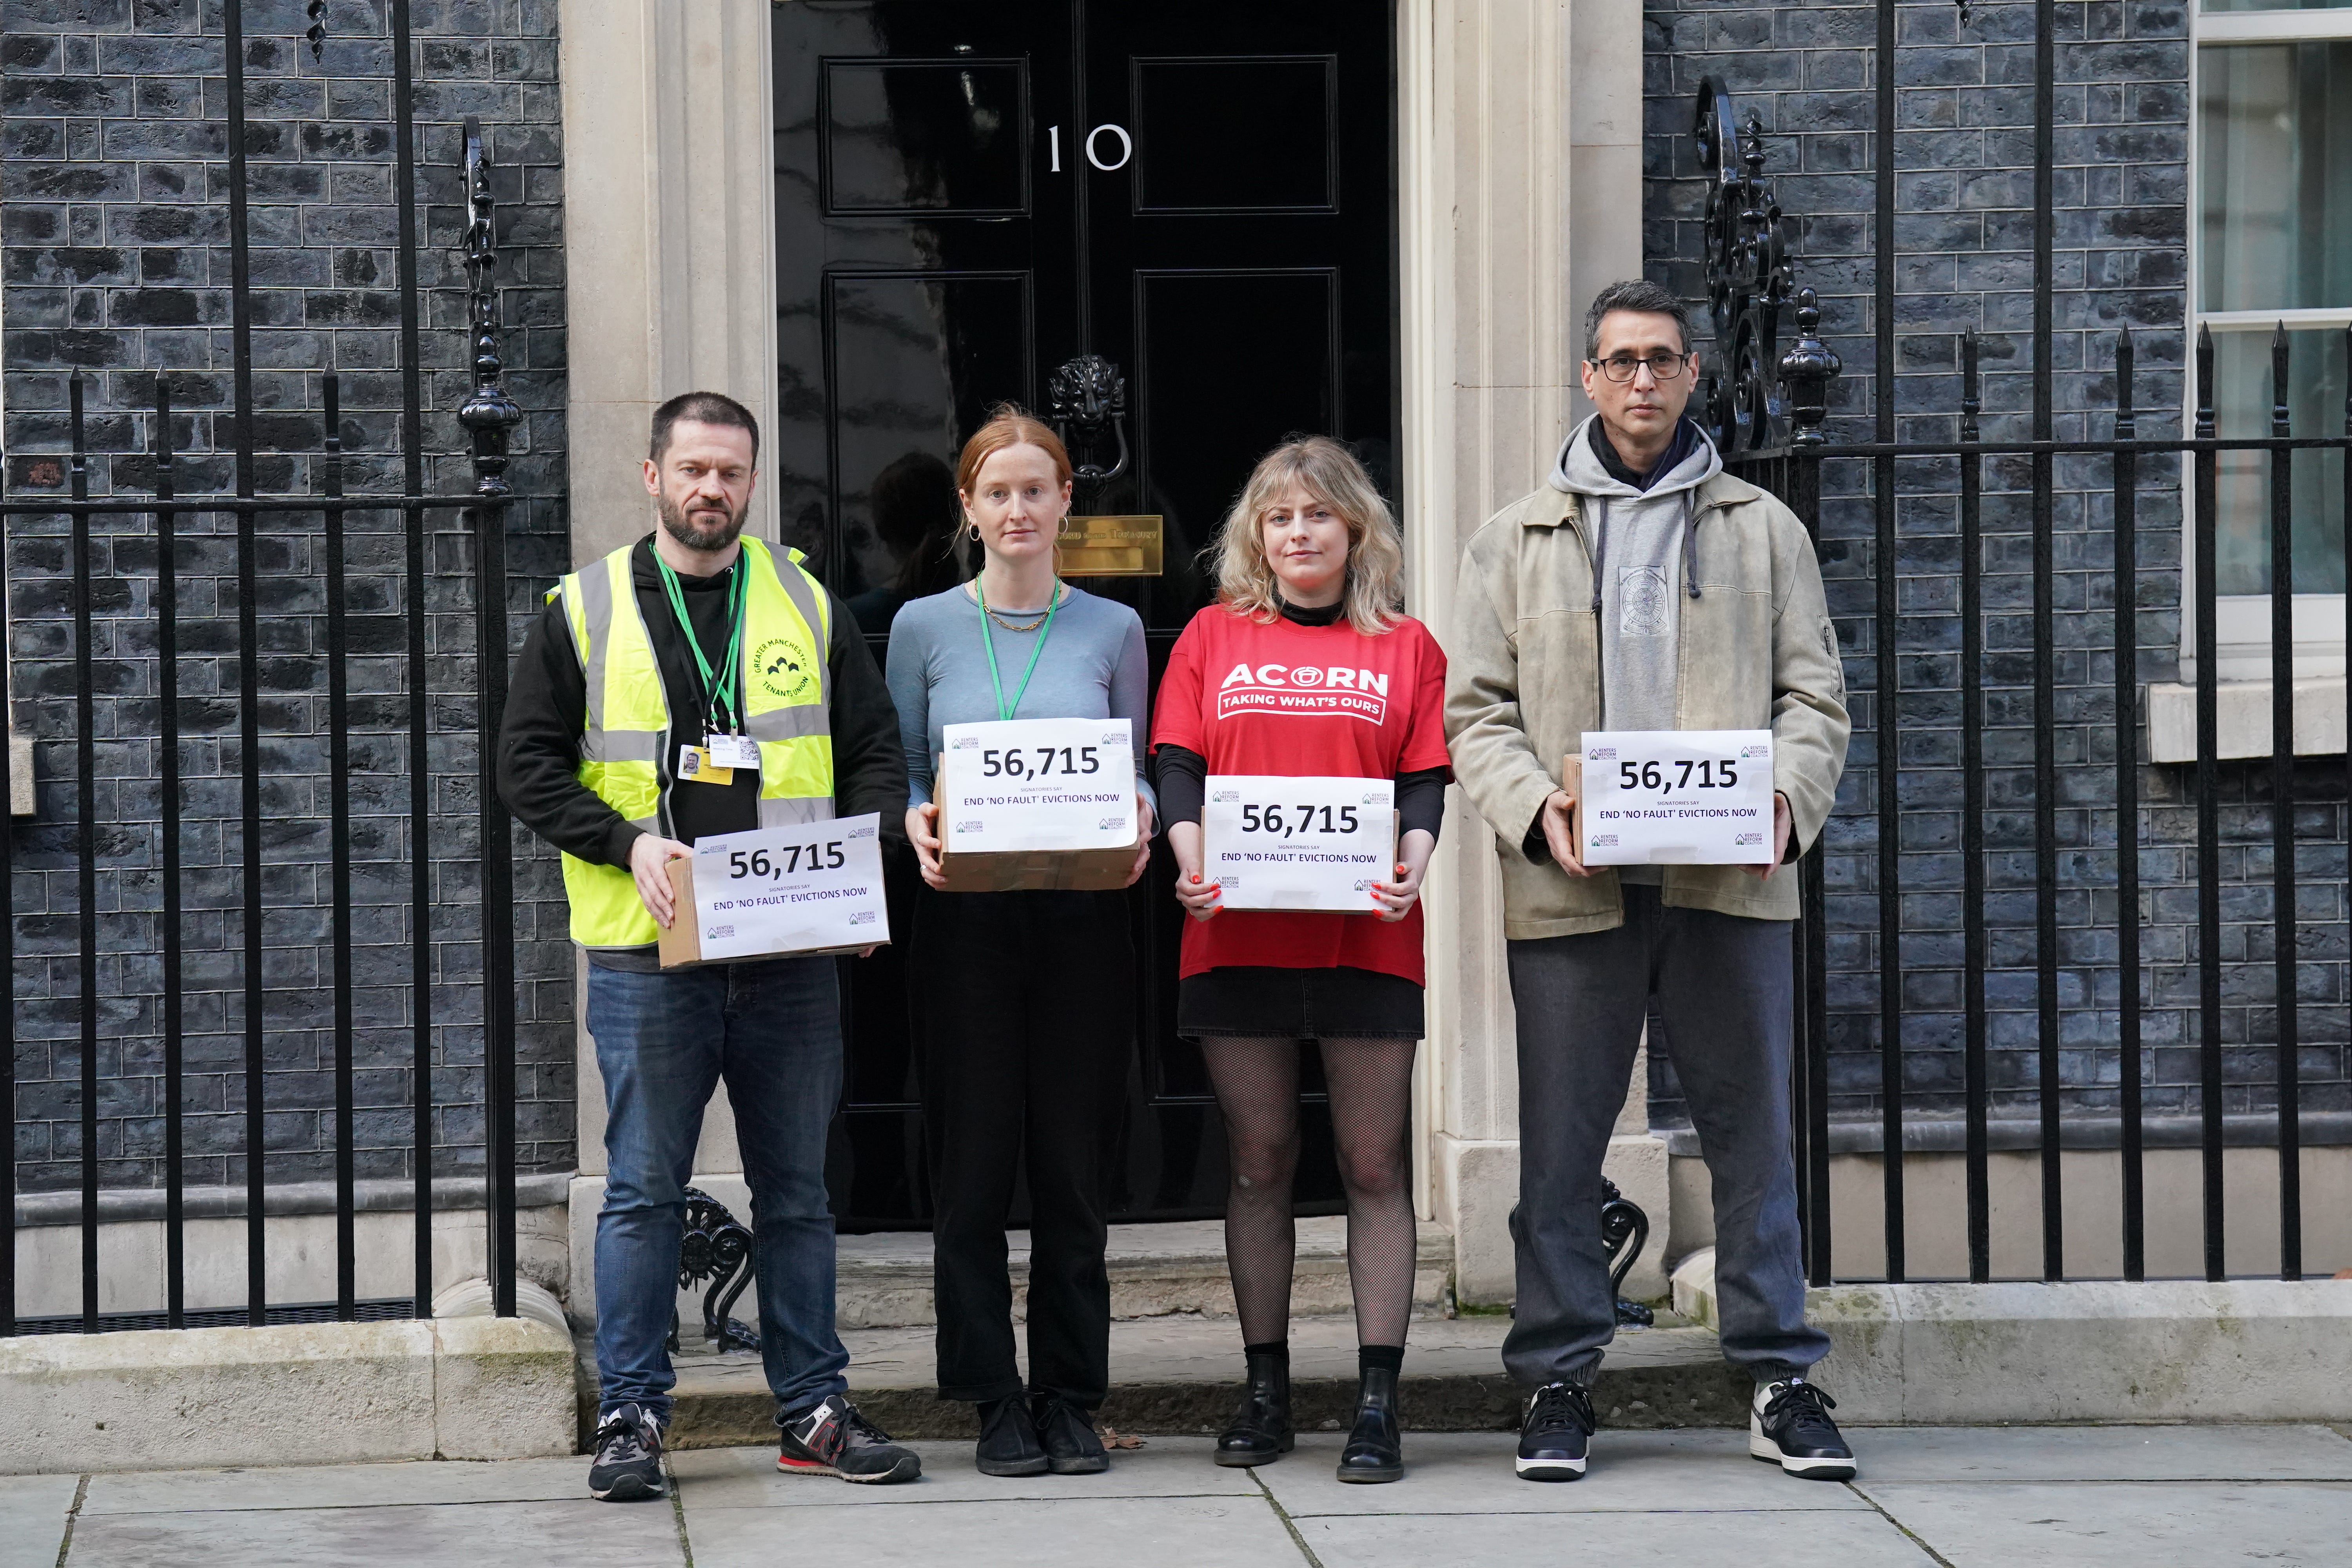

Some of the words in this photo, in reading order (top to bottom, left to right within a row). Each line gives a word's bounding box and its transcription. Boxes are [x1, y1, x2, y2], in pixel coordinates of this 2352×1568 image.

[1048, 124, 1132, 172] 10
[754, 644, 768, 673] GREATER
[768, 639, 807, 667] MANCHESTER
[763, 681, 793, 697] TENANTS
[793, 676, 808, 695] UNION
[1221, 663, 1388, 697] ACORN
[1223, 694, 1275, 708] TAKING
[1279, 696, 1337, 707] WHAT'S
[1341, 697, 1380, 715] OURS
[984, 747, 1099, 781] 56,715
[1621, 760, 1737, 795] 56,715
[1008, 796, 1039, 804] FAULT'
[1042, 795, 1092, 803] EVICTIONS
[1644, 809, 1675, 818] FAULT'
[1679, 809, 1729, 817] EVICTIONS
[1242, 804, 1358, 838] 56,715
[731, 841, 844, 880] 56,715
[1299, 854, 1348, 862] EVICTIONS
[714, 901, 733, 910] END
[757, 895, 788, 906] FAULT'
[791, 890, 840, 902] EVICTIONS
[843, 887, 867, 897] NOW
